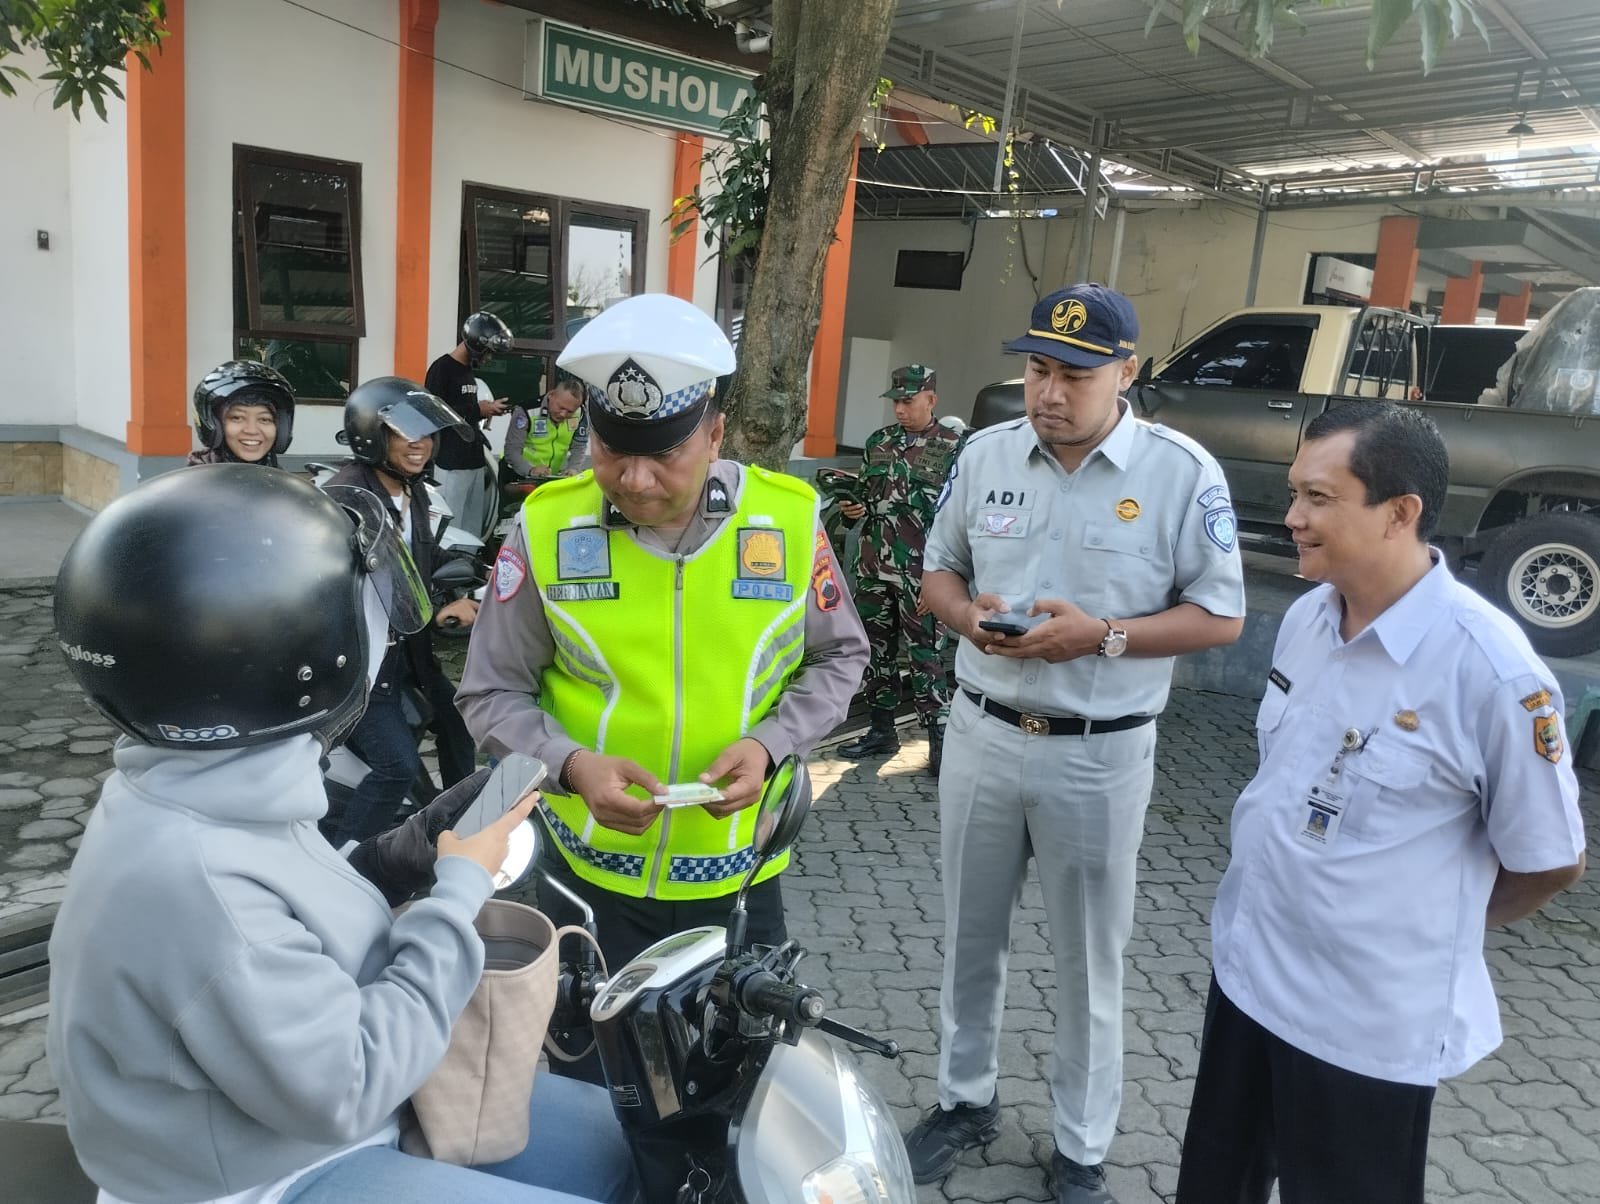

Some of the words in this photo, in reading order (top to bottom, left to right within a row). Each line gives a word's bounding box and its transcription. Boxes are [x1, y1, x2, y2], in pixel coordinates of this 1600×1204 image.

[555, 43, 750, 121] MUSHOLA
[985, 489, 1025, 506] ADI
[738, 583, 791, 599] POLRI
